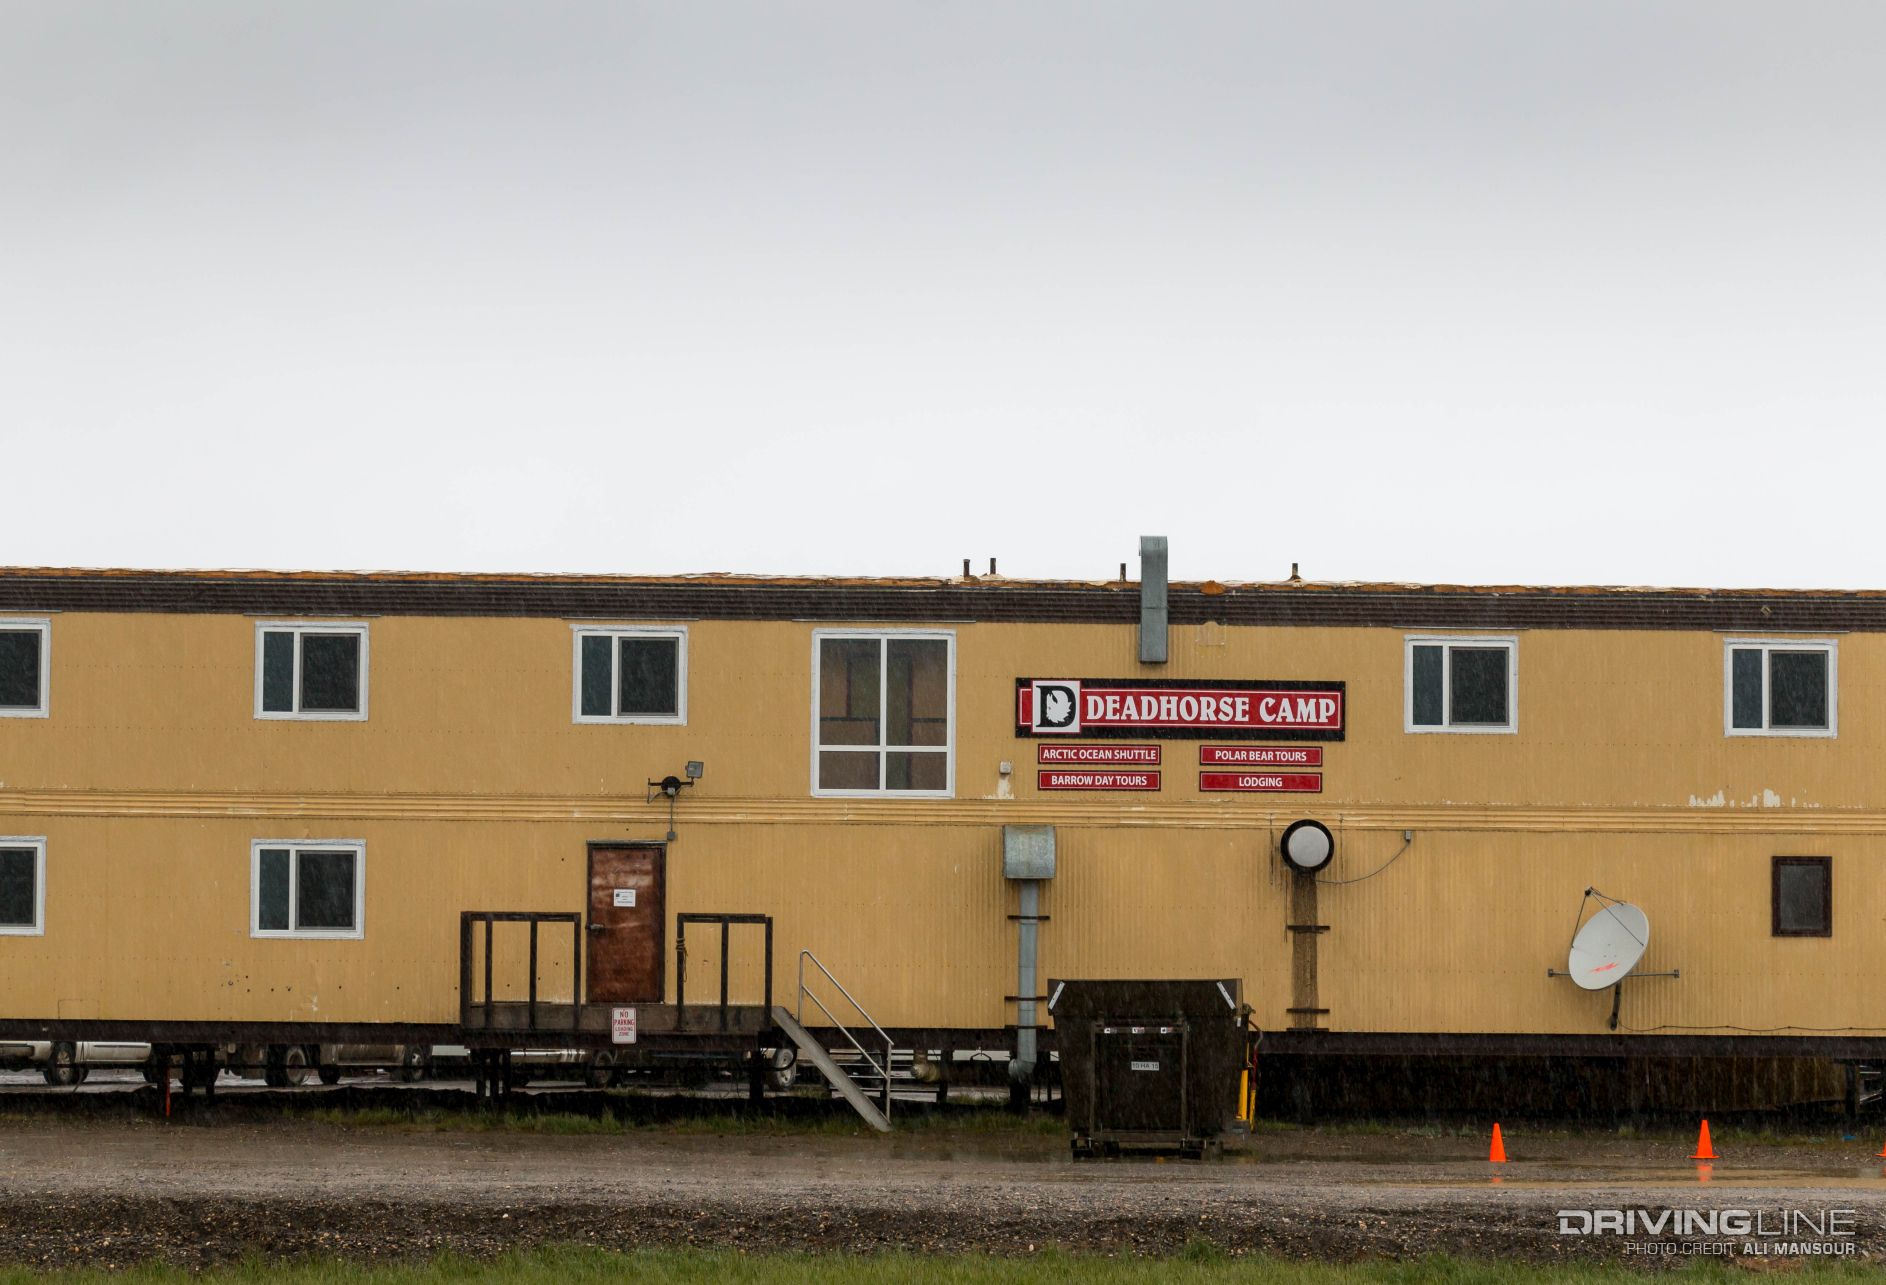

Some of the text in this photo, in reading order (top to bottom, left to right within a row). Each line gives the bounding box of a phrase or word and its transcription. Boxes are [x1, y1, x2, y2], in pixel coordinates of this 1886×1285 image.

[1086, 695, 1336, 723] DEADHORSE CAMP
[1043, 749, 1156, 761] ARCTIC OCEAN SHUTTLE
[1215, 750, 1307, 761] POLAR BEAR TOURS
[1051, 775, 1147, 786] BARROW DAY TOURS
[1239, 777, 1283, 788] LODGING
